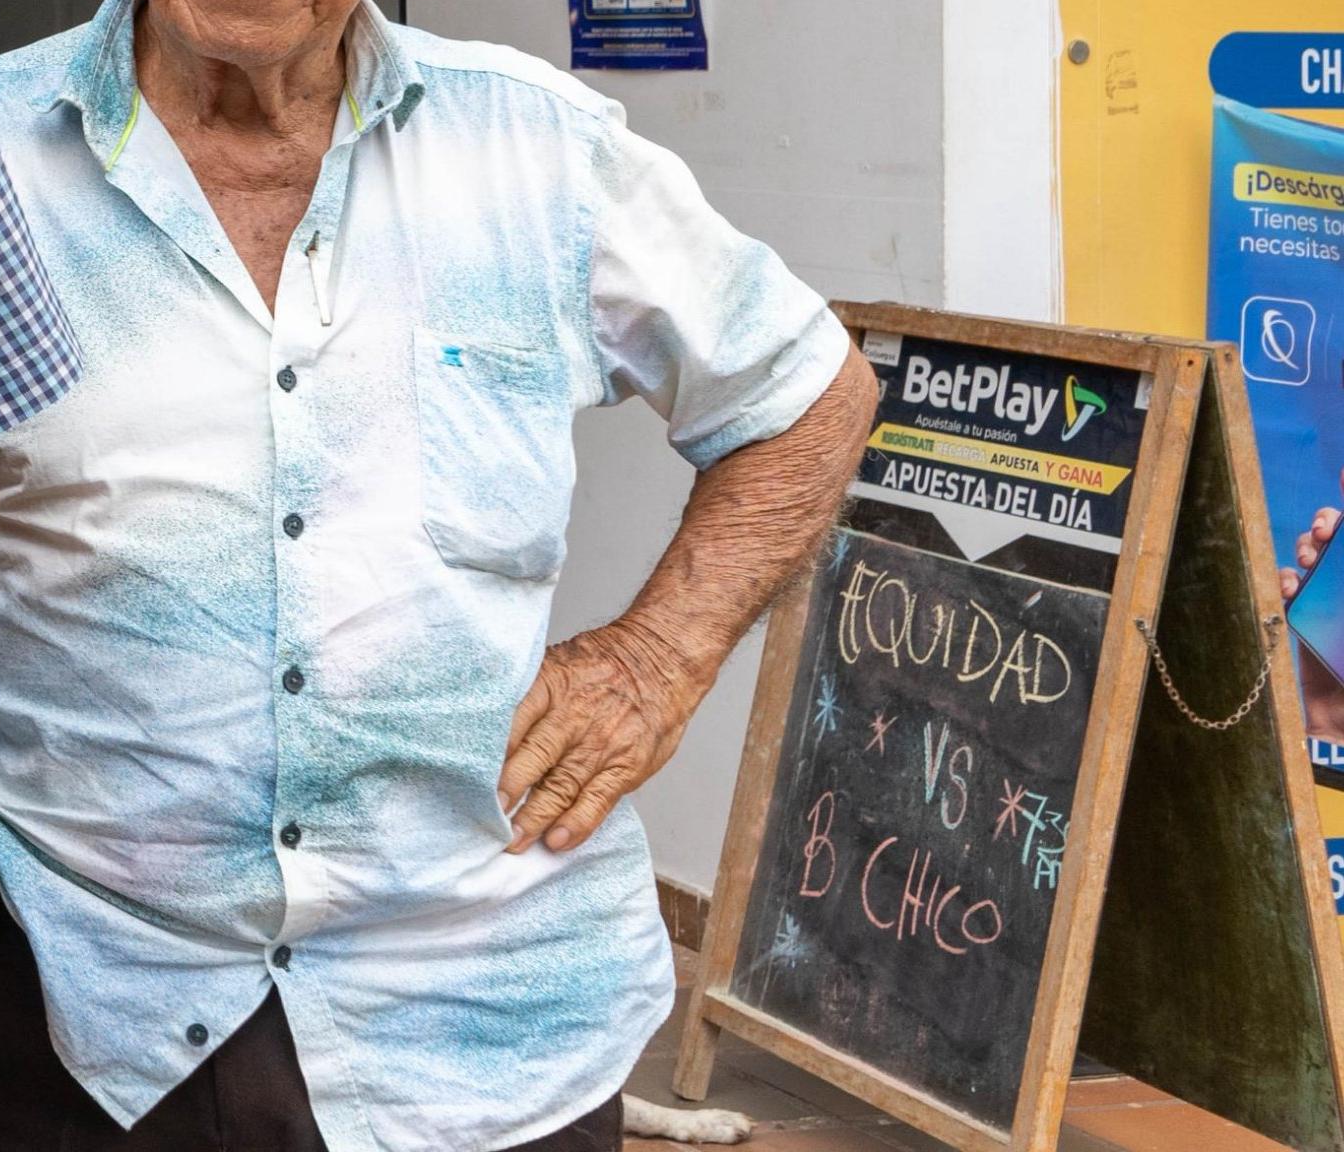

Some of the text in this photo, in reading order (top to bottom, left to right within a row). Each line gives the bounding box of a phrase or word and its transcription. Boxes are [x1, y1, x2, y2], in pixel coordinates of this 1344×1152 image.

[1240, 235, 1340, 262] necesitas
[1249, 207, 1318, 233] Tienes
[902, 355, 1058, 436] BetPlay
[915, 413, 1018, 443] Apuéstale a tu pasión
[881, 459, 1093, 531] APUESTA DEL DÍA
[990, 452, 1039, 473] APUESTA
[1045, 461, 1054, 477] Y
[1058, 463, 1104, 488] GANA
[837, 559, 1071, 705] EQUIDAD
[923, 719, 974, 830] VS
[798, 789, 1003, 956] B CHICO
